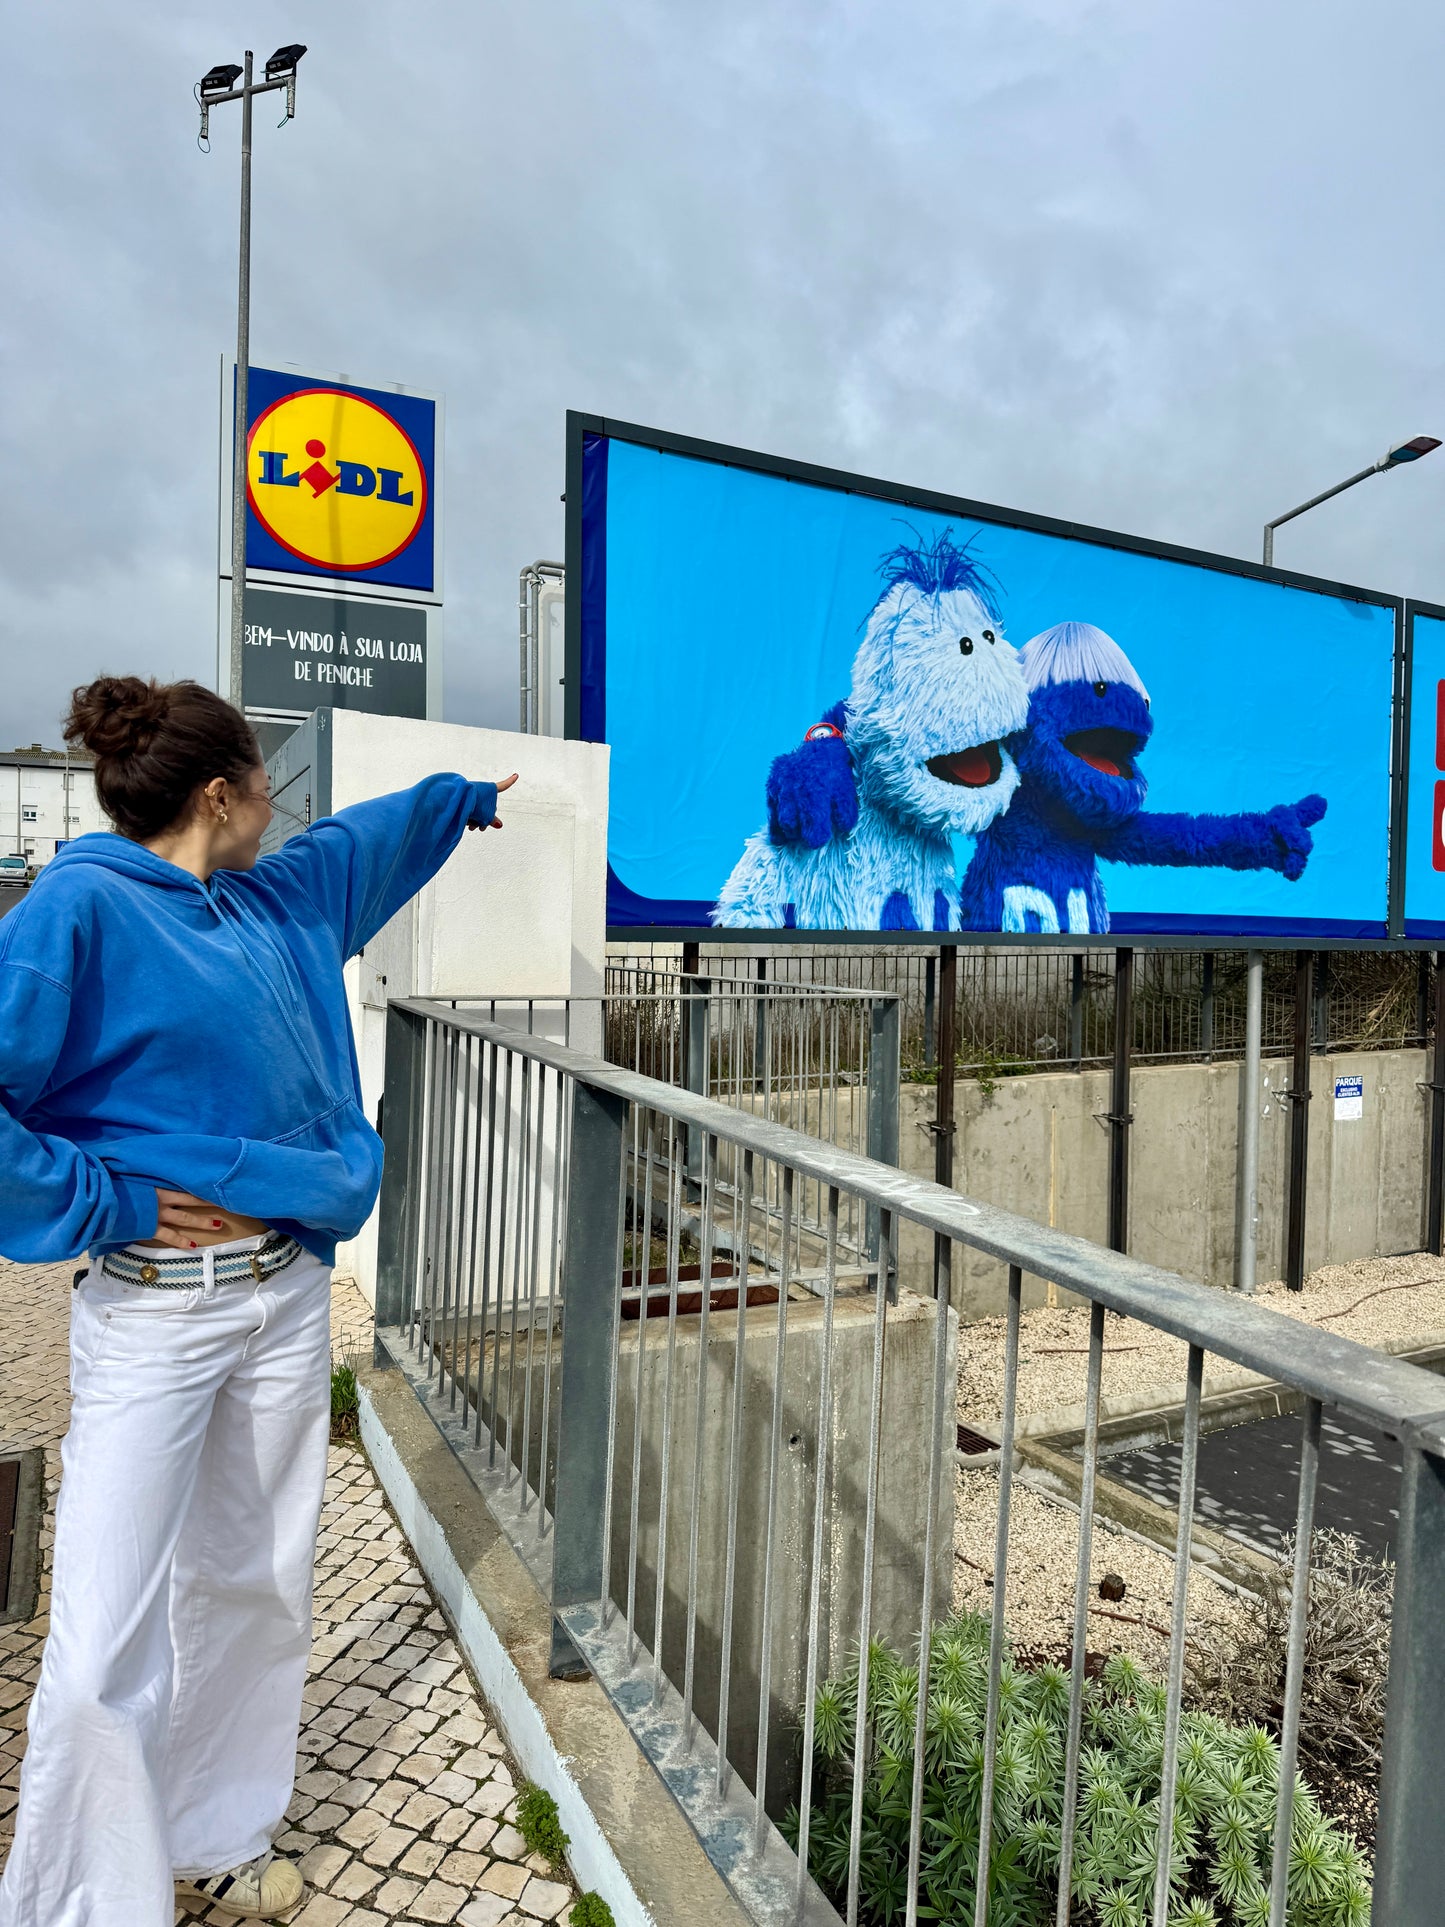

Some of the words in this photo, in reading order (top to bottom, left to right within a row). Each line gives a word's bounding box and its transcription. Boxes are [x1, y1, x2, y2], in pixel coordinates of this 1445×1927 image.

[339, 631, 349, 655] À
[354, 637, 384, 659] SUA
[390, 640, 423, 663] LOJA
[294, 660, 312, 681] DE
[318, 662, 374, 687] PENICHE
[1336, 1077, 1362, 1086] PARQUE
